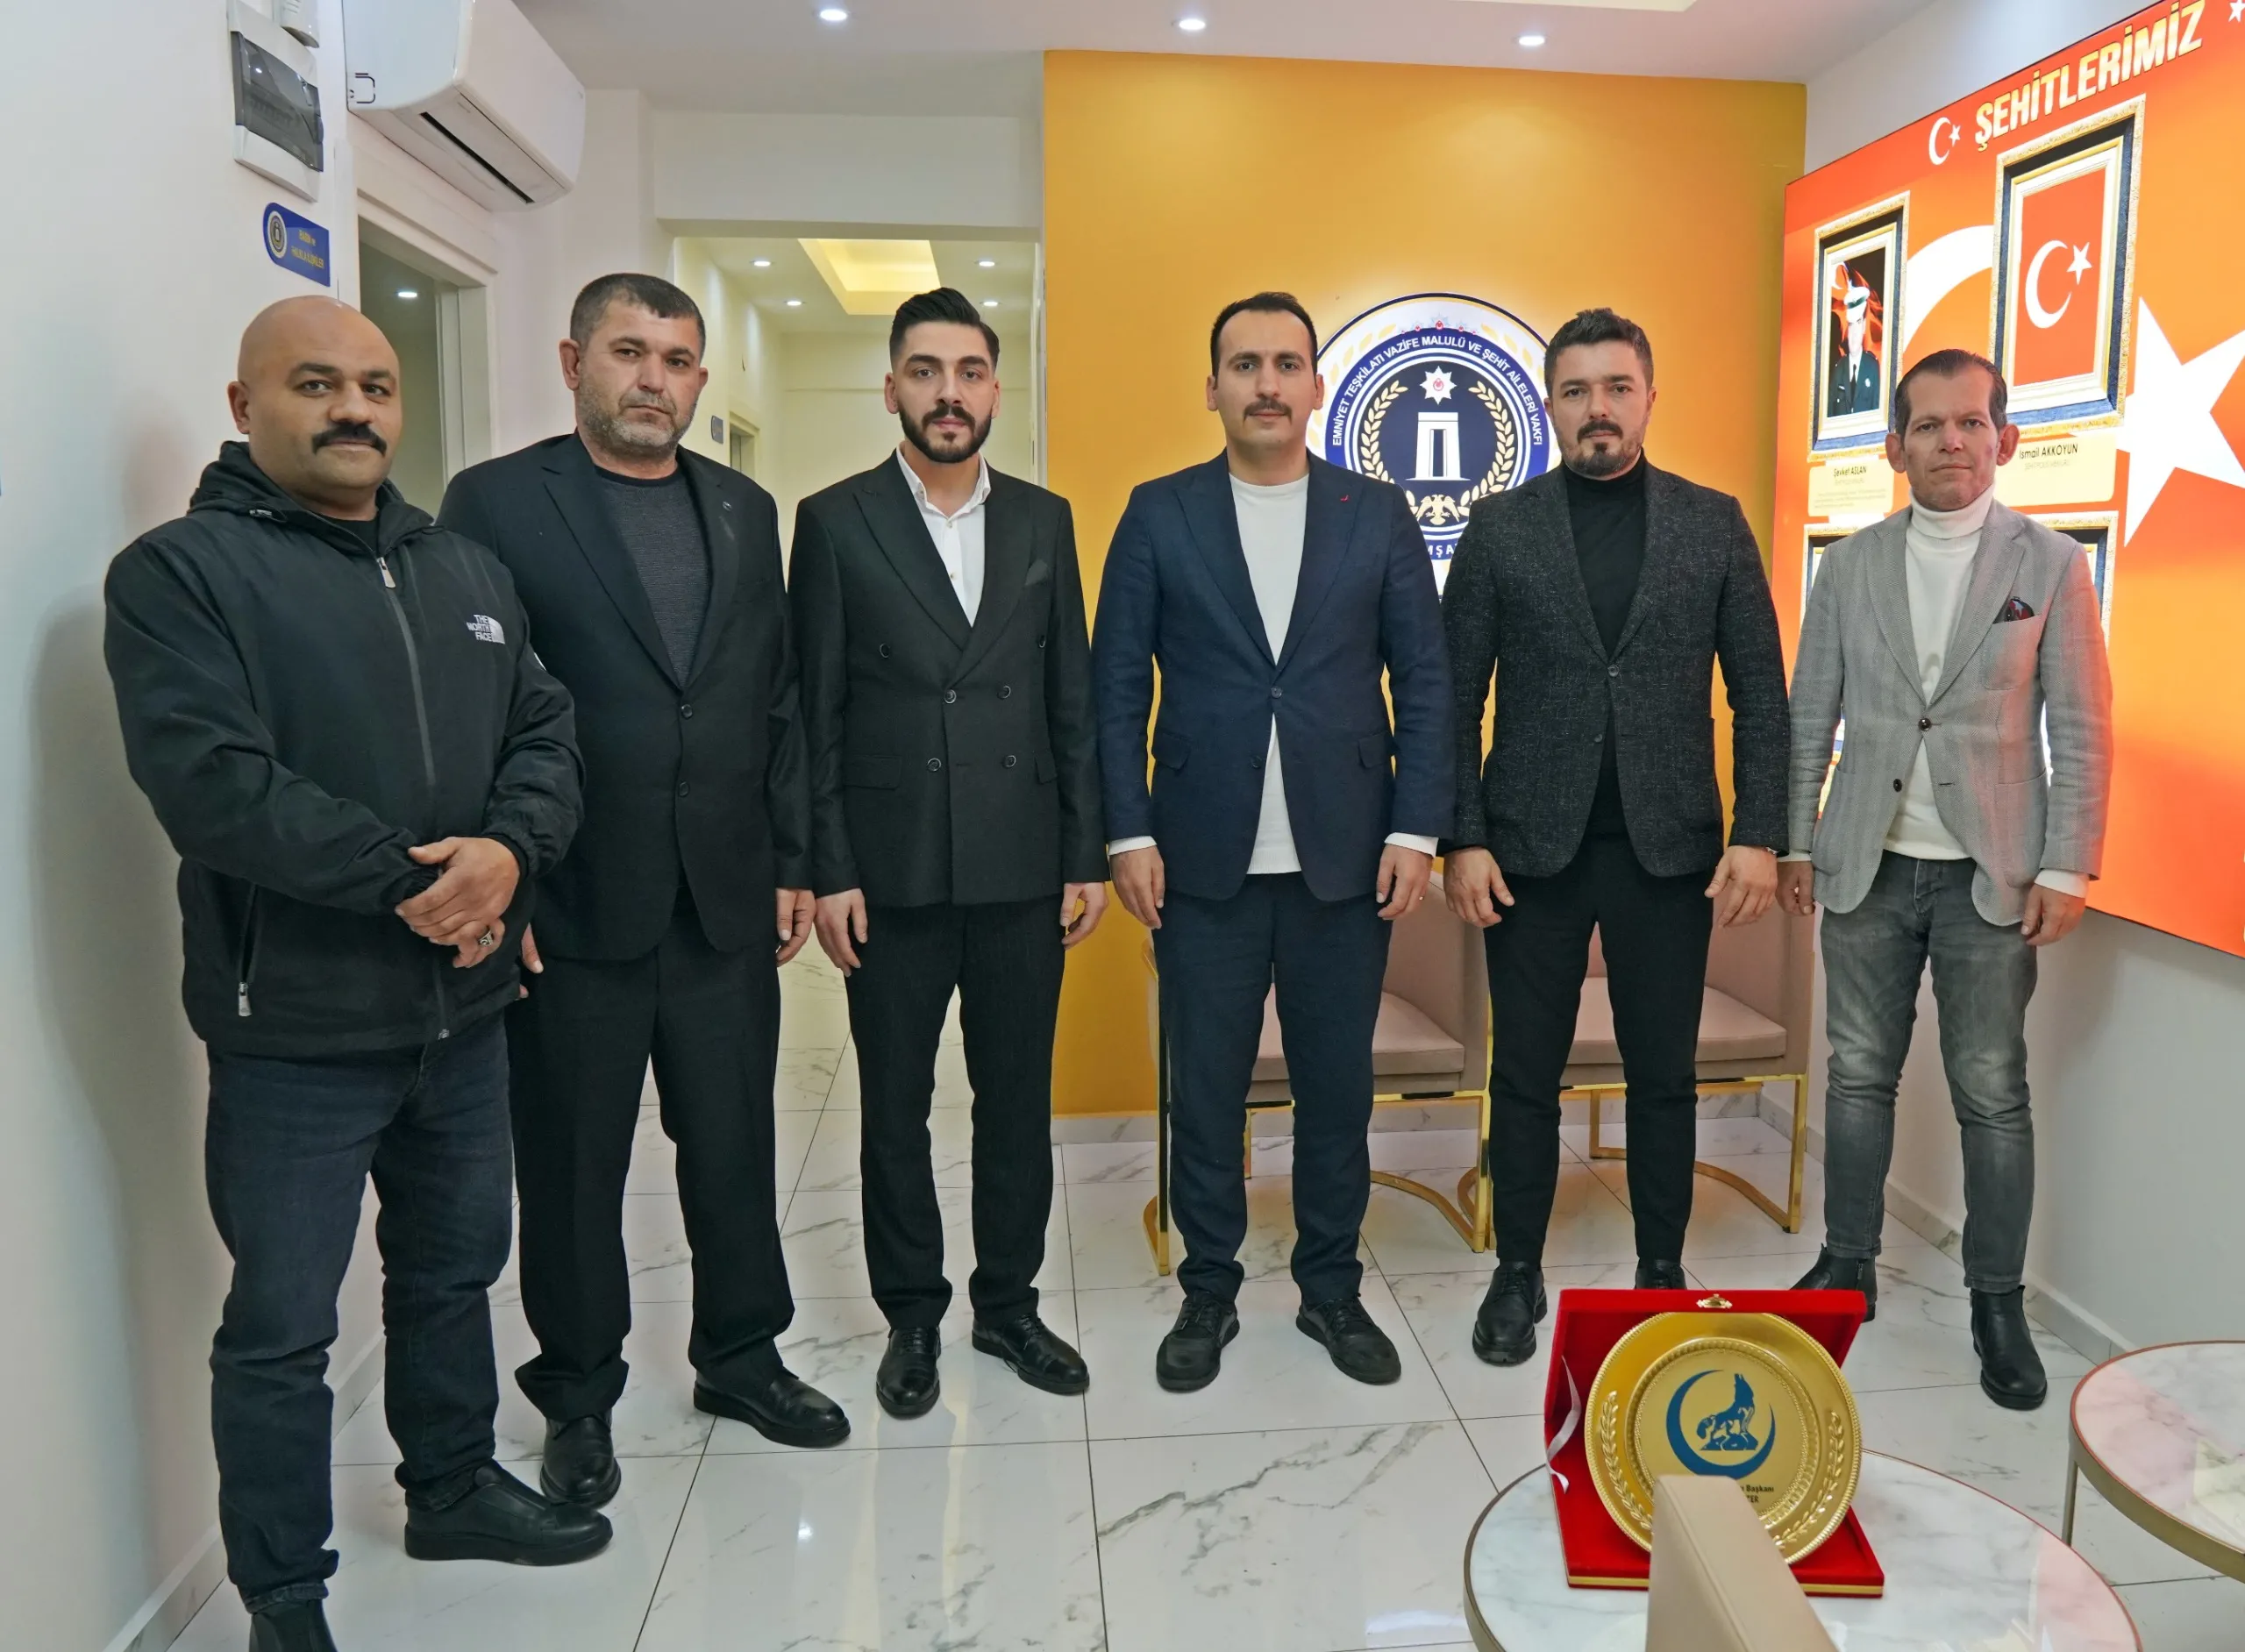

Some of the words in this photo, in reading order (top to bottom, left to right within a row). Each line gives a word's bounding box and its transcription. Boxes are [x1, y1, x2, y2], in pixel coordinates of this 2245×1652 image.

[1975, 0, 2206, 152] ŞEHİTLERİMİZ
[1333, 398, 1350, 446] EMNİYET
[1344, 353, 1386, 398] TEŞKİLATI
[1383, 338, 1420, 359] VAZİFE
[1422, 336, 1466, 348] MALULÜ
[1468, 340, 1482, 354] VE
[1482, 349, 1511, 372] ŞEHİT
[1507, 370, 1539, 413] AİLELERİ
[1529, 413, 1543, 445] VAKFI
[2042, 443, 2078, 458] AKKOYUN
[1850, 466, 1867, 476] ASLAN
[474, 615, 489, 624] THE
[467, 623, 492, 632] NORTH
[475, 631, 493, 642] FACE
[1746, 1485, 1774, 1493] Başkanı
